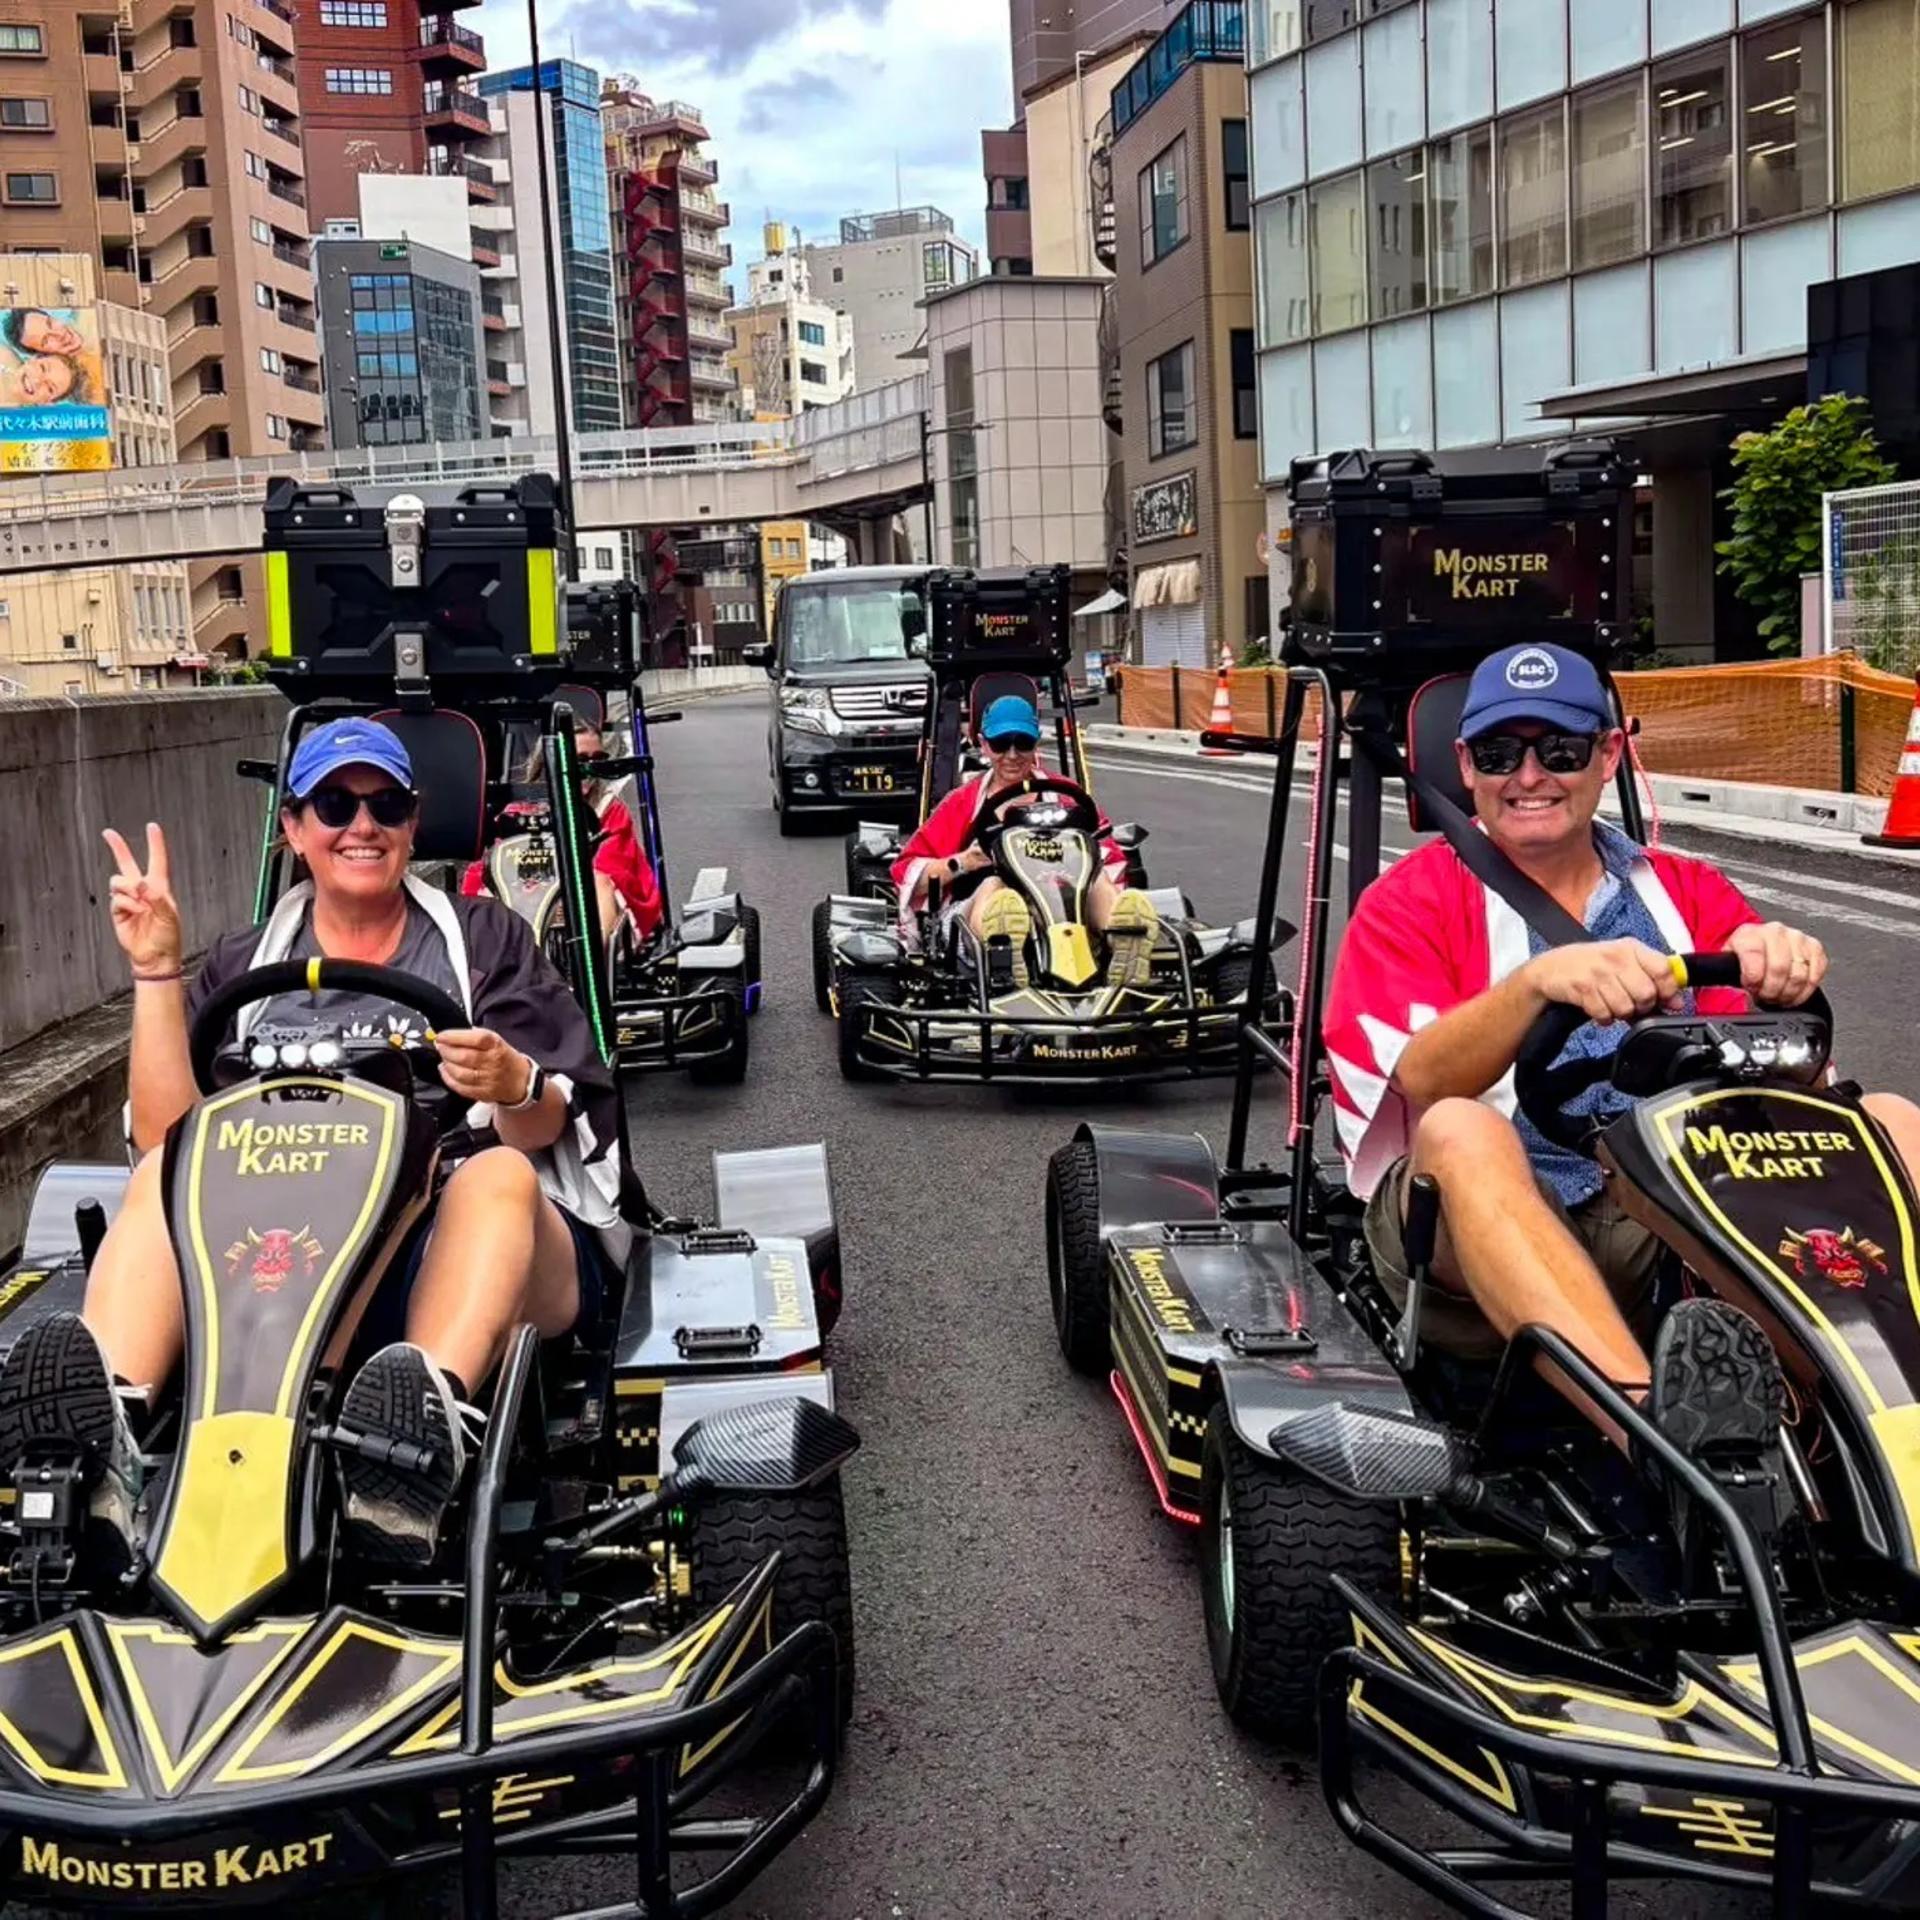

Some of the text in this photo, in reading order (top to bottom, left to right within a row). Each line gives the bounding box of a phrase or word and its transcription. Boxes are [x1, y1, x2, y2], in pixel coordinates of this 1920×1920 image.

[1434, 548, 1548, 576] MONSTER
[1452, 573, 1520, 598] KART
[975, 613, 1029, 627] MONSTER
[984, 625, 1017, 638] KART
[505, 847, 556, 858] MONSTE
[1032, 1044, 1138, 1059] MONSTER KART
[217, 1118, 370, 1150] MONSTER
[1685, 1125, 1856, 1159] MONSTER
[237, 1146, 330, 1175] KART
[1724, 1150, 1823, 1178] KART
[22, 1833, 333, 1889] MONSTER KART
